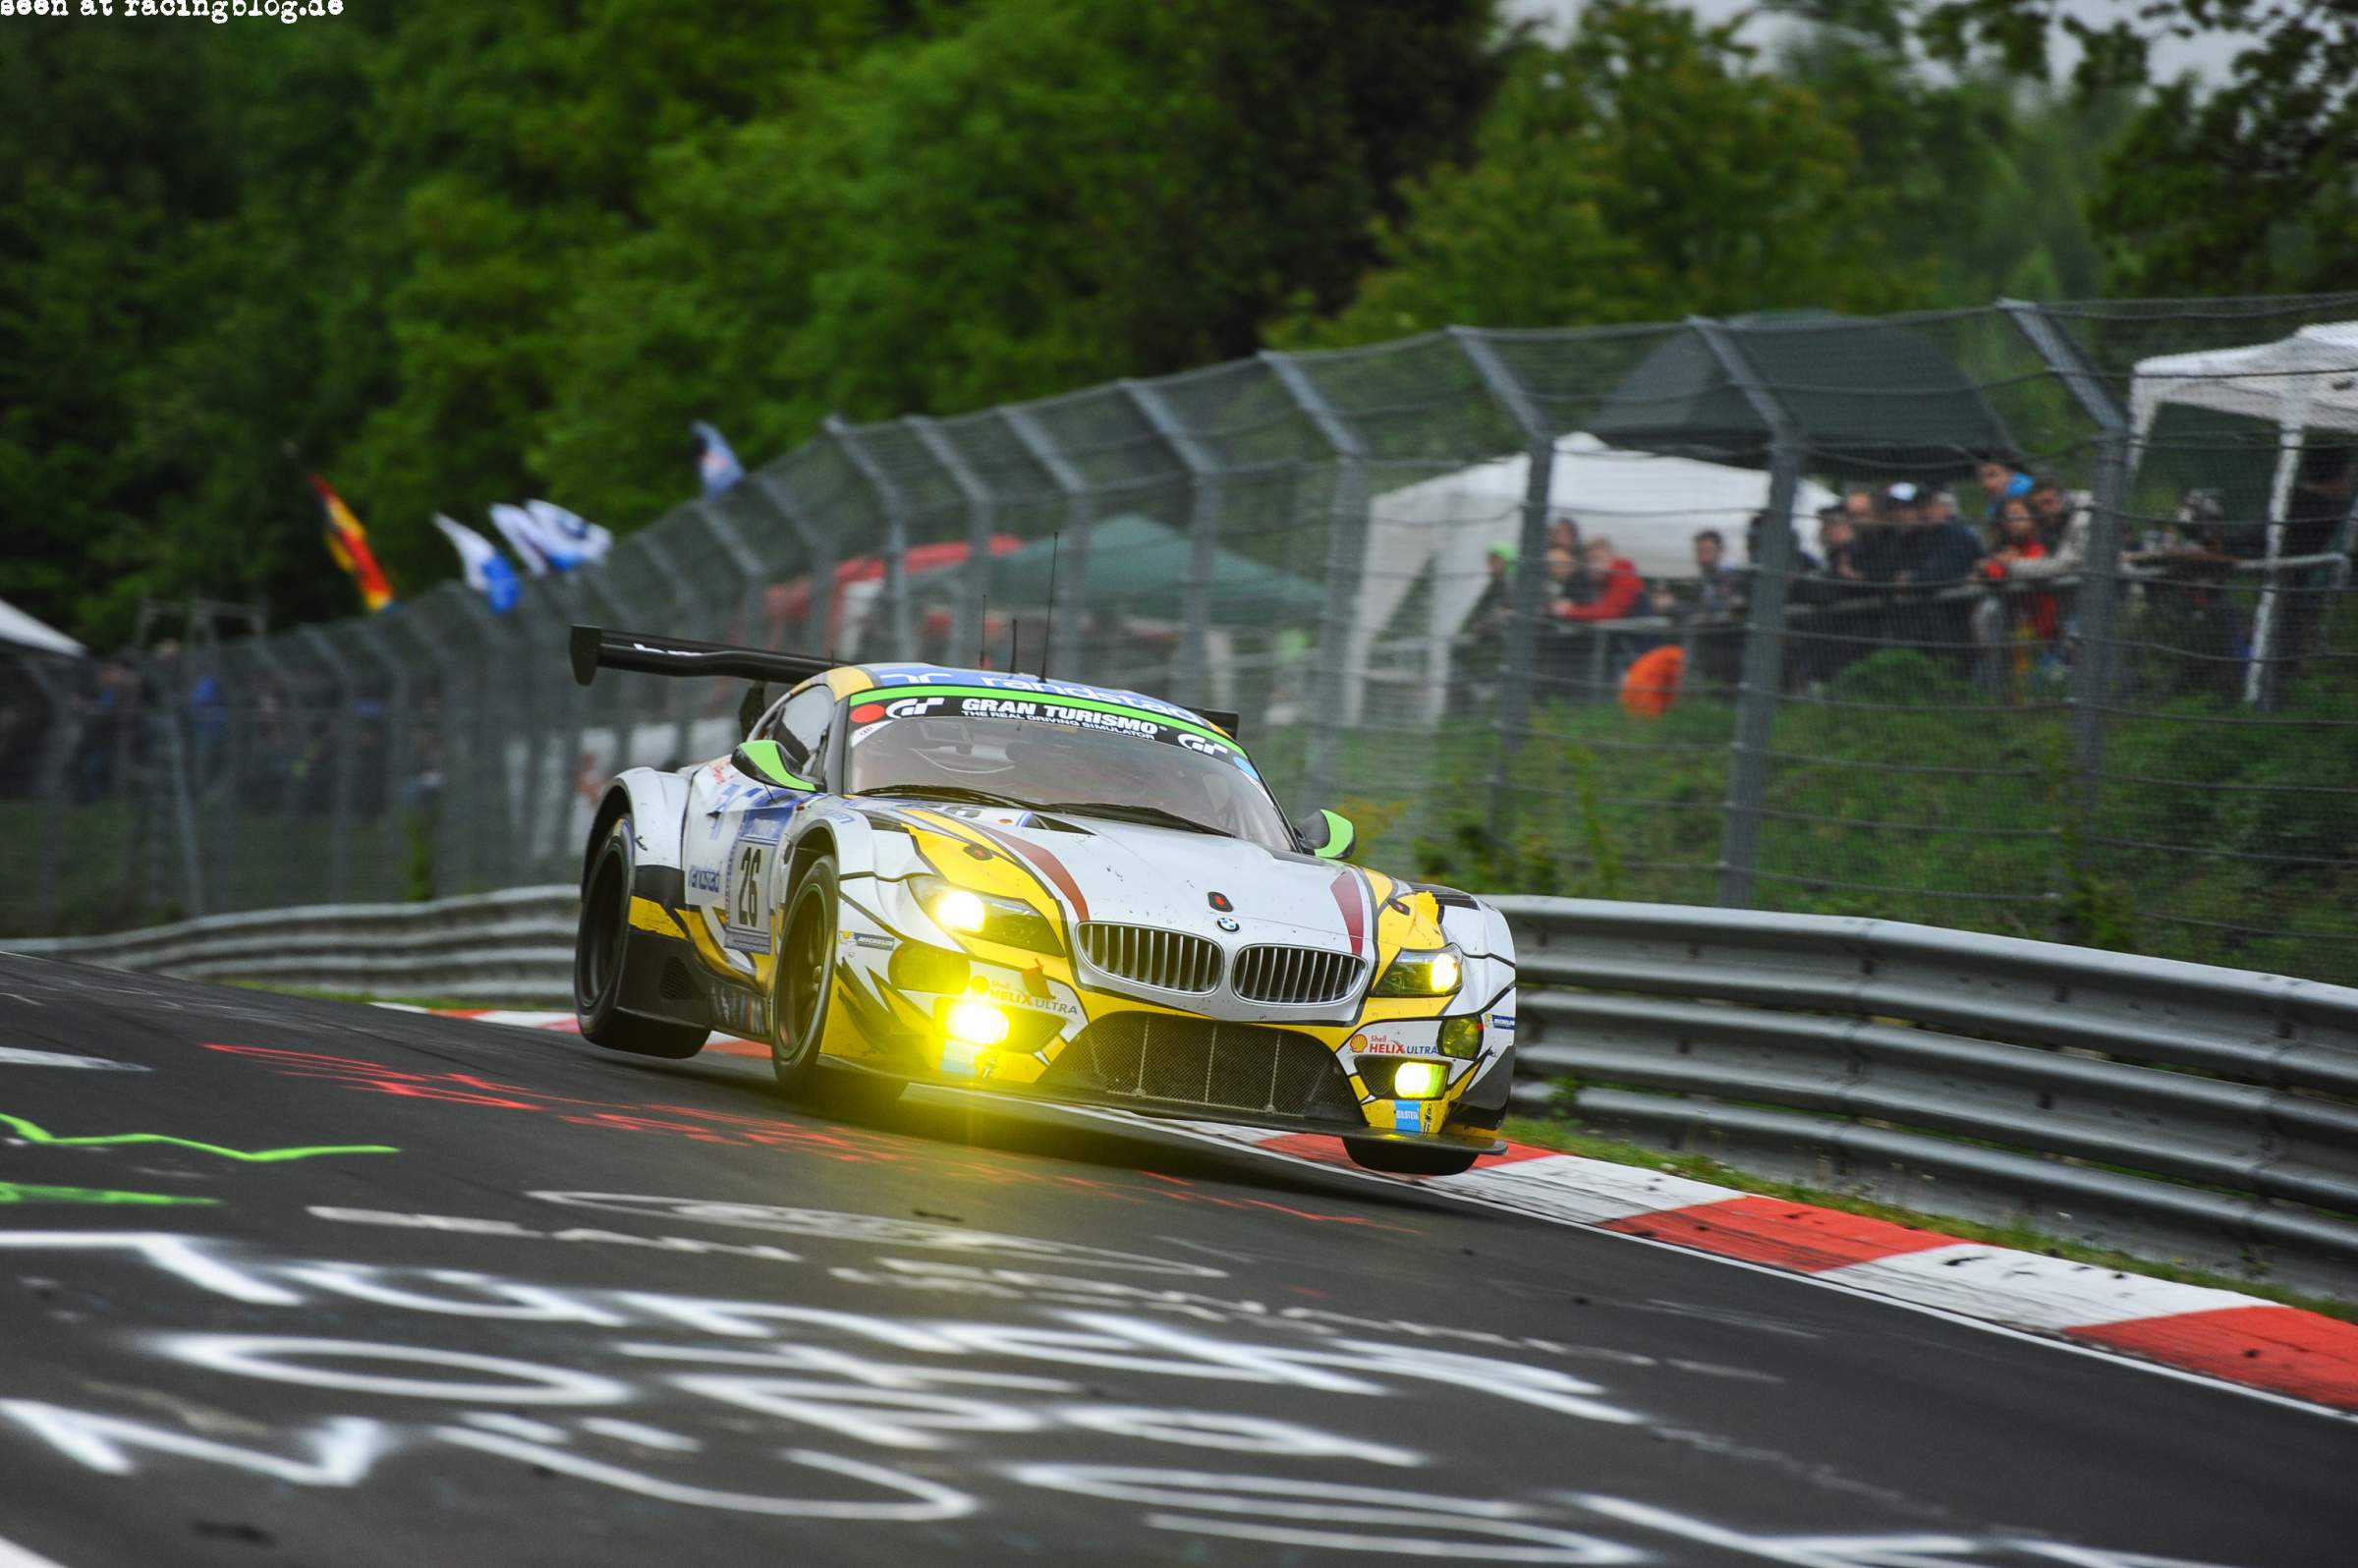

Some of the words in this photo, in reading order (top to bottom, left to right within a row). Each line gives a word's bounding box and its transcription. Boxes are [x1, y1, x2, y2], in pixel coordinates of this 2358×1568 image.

[961, 698, 1037, 717] GRAN
[1043, 704, 1158, 735] TURISMO
[961, 709, 988, 718] THE
[987, 711, 1026, 721] REAL
[1025, 715, 1082, 727] DRIVING
[1082, 720, 1155, 741] SIMULATOR
[739, 846, 762, 927] 26
[989, 989, 1033, 1007] HELIX
[1035, 998, 1079, 1015] ULTRA
[1369, 1042, 1406, 1054] HELIX
[1406, 1045, 1439, 1054] ULTRA
